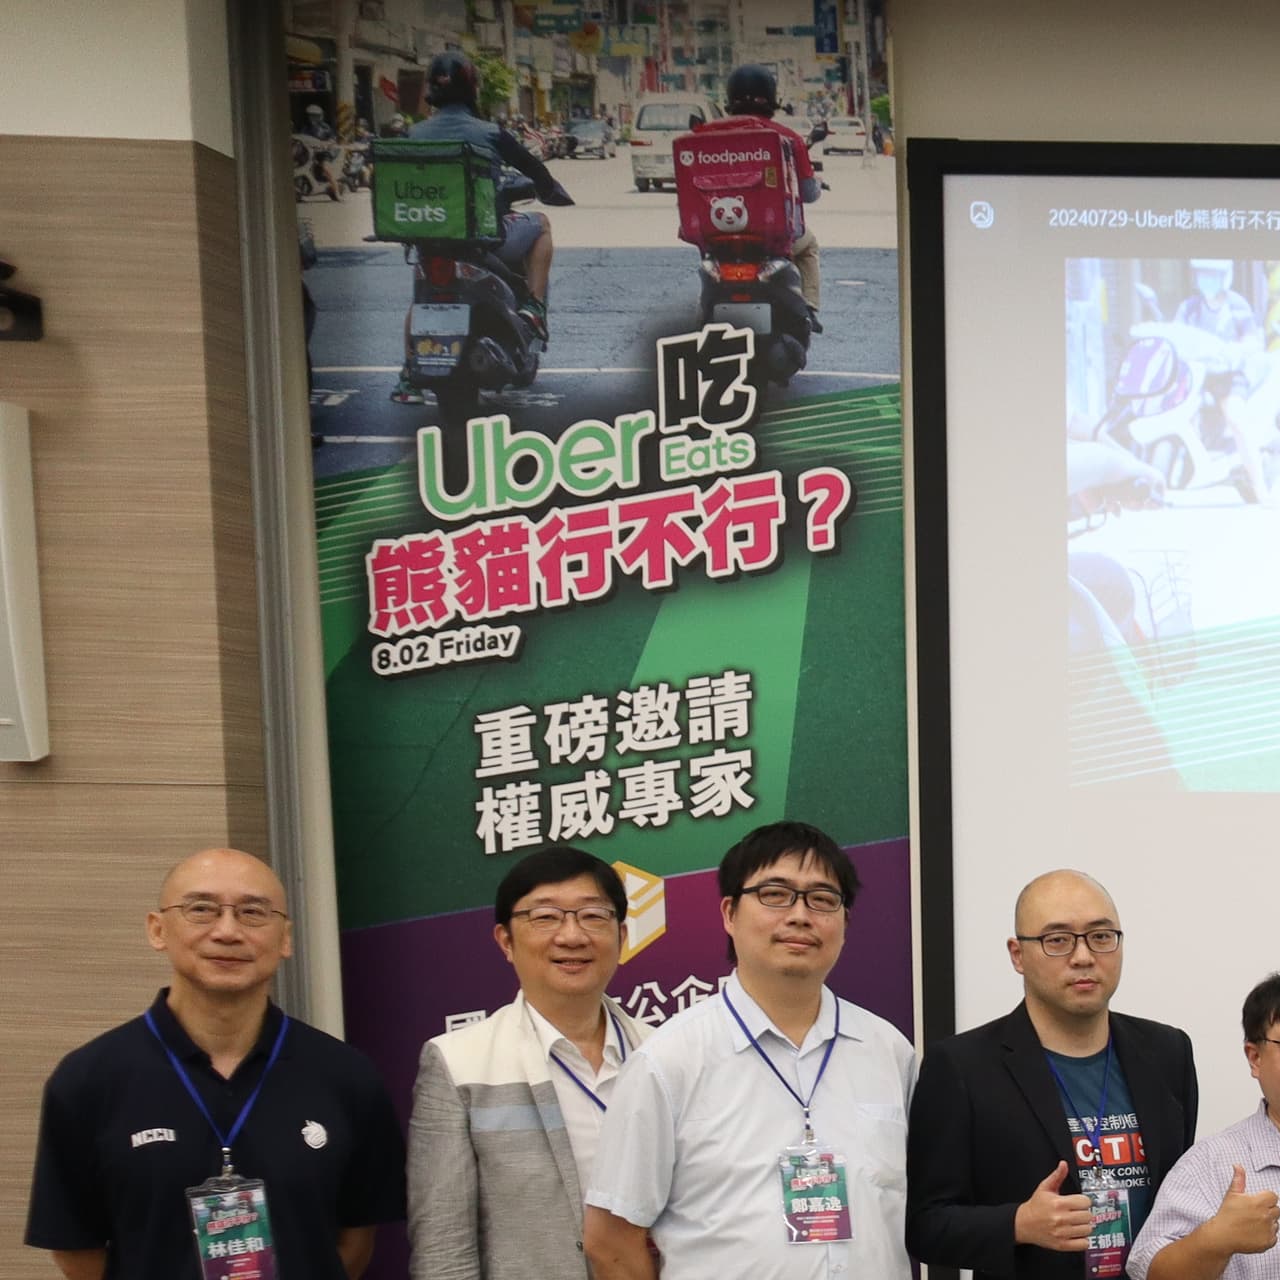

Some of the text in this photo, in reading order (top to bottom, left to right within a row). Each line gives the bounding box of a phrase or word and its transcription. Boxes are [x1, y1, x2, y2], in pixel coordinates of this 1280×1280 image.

[697, 148, 771, 166] foodpanda
[394, 182, 447, 201] Uber
[394, 203, 447, 223] Eats
[660, 326, 753, 433] 吃
[420, 416, 752, 516] Uber Eats
[367, 472, 848, 633] 熊貓行不行？
[376, 629, 515, 672] 8.02 Friday
[473, 671, 753, 779] 重磅邀請
[474, 748, 755, 855] 權威專家
[131, 1127, 177, 1149] NCCU
[207, 1236, 265, 1259] 林佳和
